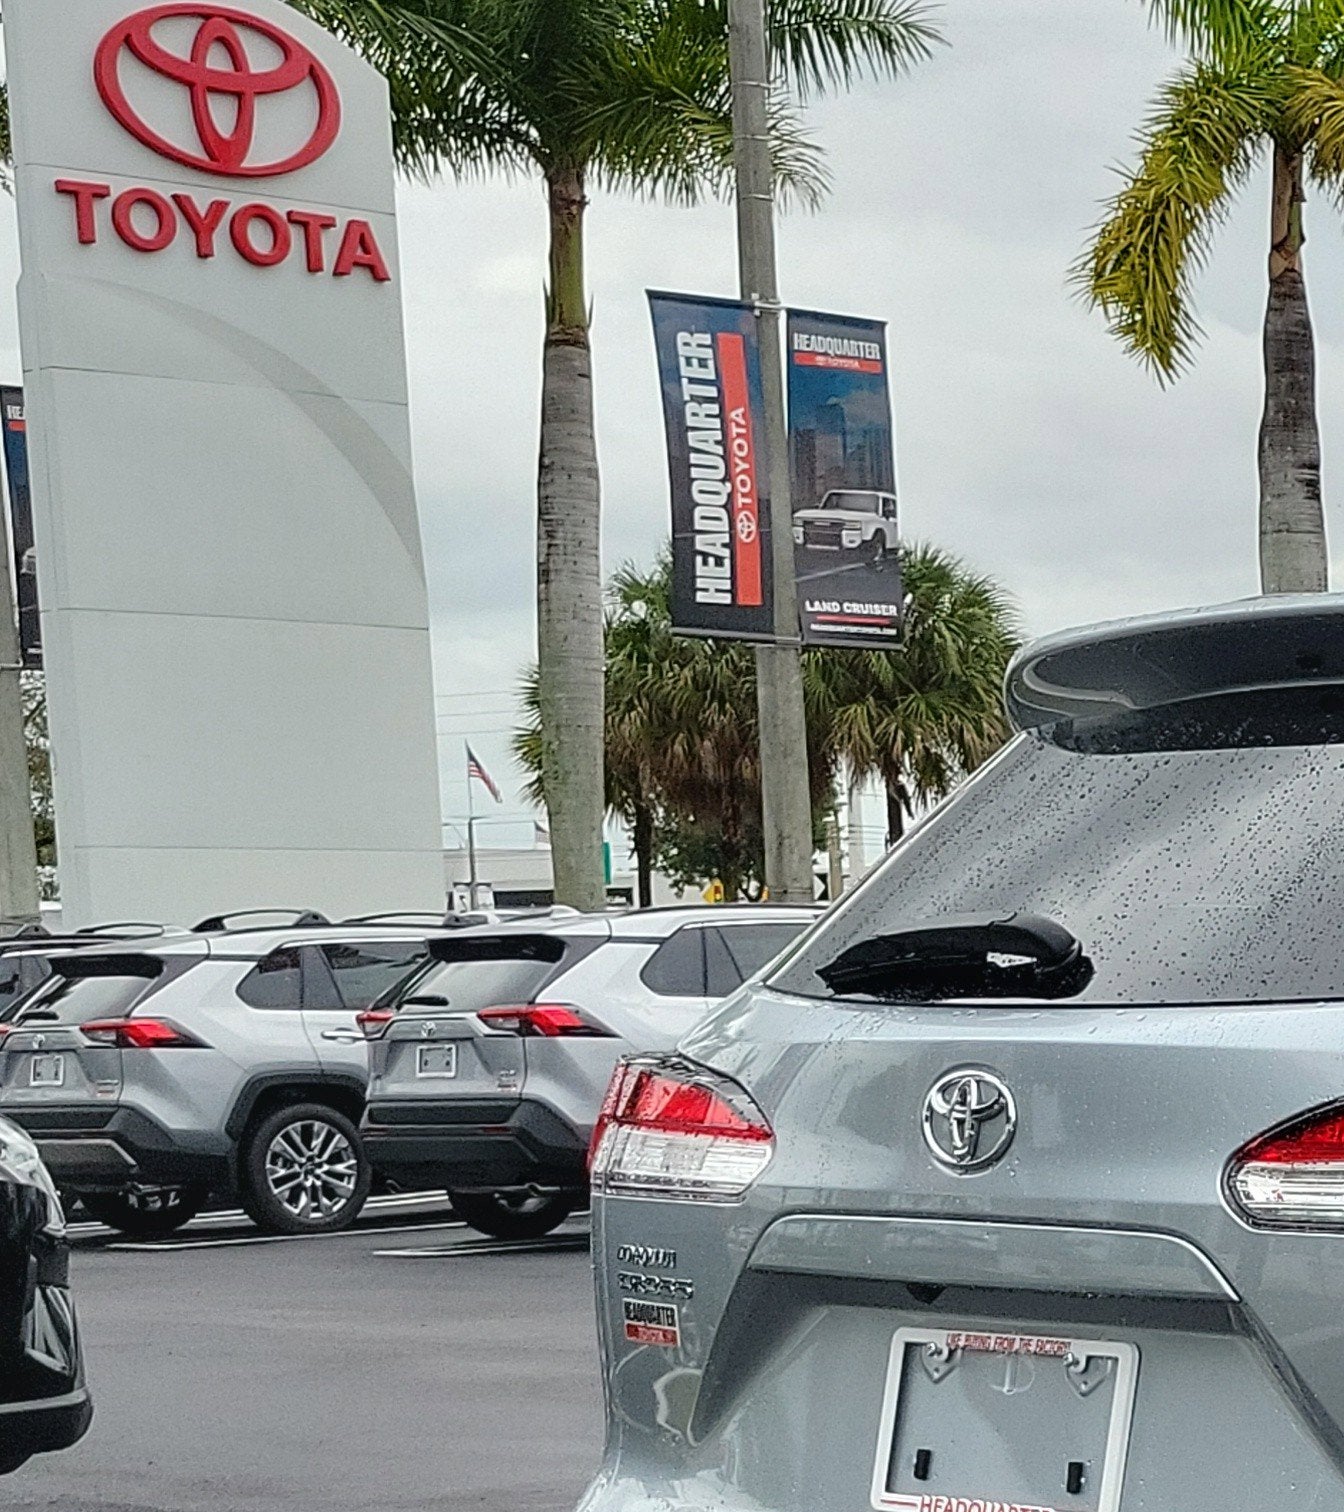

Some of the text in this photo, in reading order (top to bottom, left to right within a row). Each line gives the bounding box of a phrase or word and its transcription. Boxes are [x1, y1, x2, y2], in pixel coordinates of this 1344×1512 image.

[55, 179, 391, 282] TOYOTA
[793, 332, 881, 360] HEADQUARTER
[676, 331, 733, 605] HEADQUARTER
[729, 406, 754, 508] TOYOTA
[805, 600, 898, 616] LAND CRUISER
